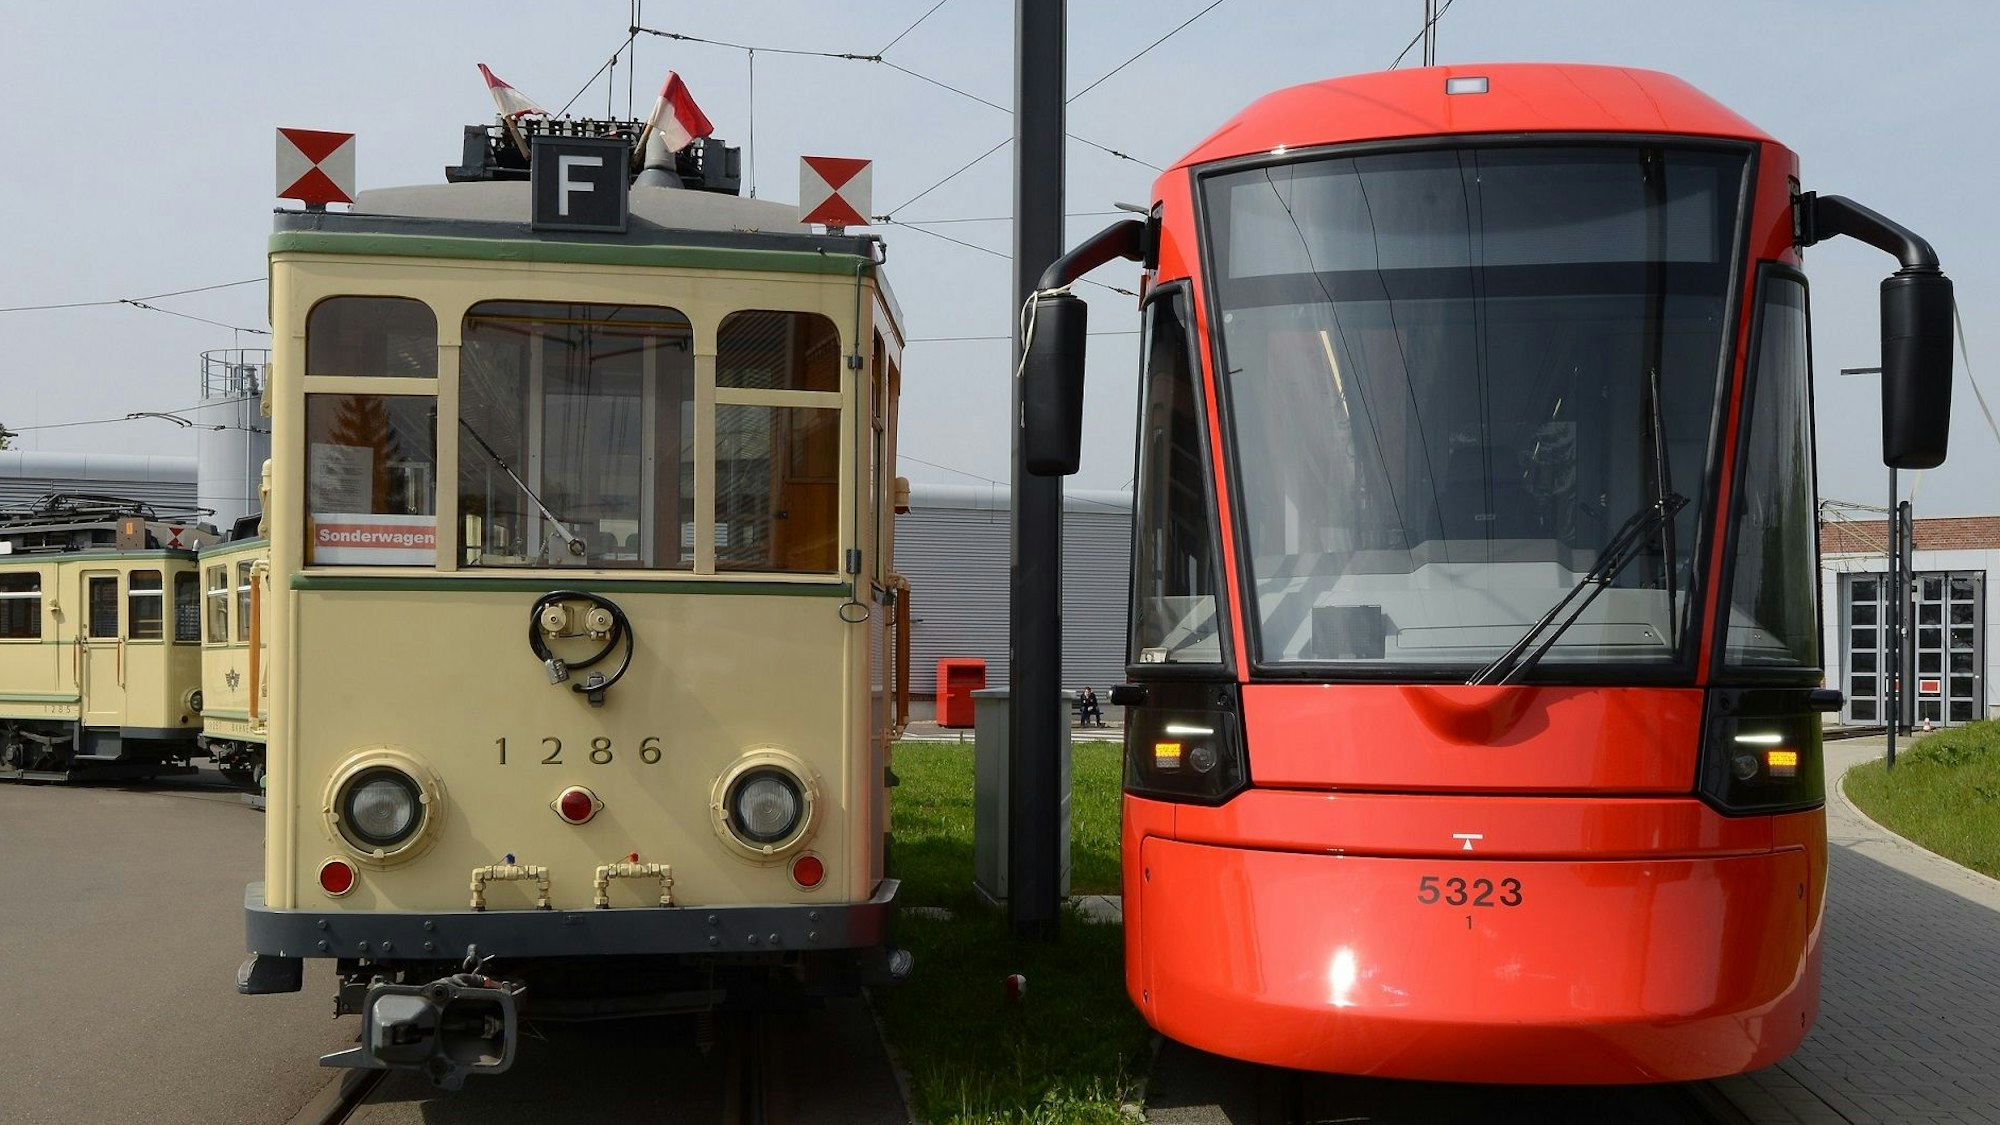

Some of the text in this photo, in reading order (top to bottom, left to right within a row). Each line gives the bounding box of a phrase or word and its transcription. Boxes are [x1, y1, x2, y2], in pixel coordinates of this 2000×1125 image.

[558, 155, 603, 216] F
[319, 528, 435, 546] Sonderwagen
[495, 736, 662, 765] 1286
[1417, 875, 1523, 907] 5323
[1465, 915, 1472, 931] 1
